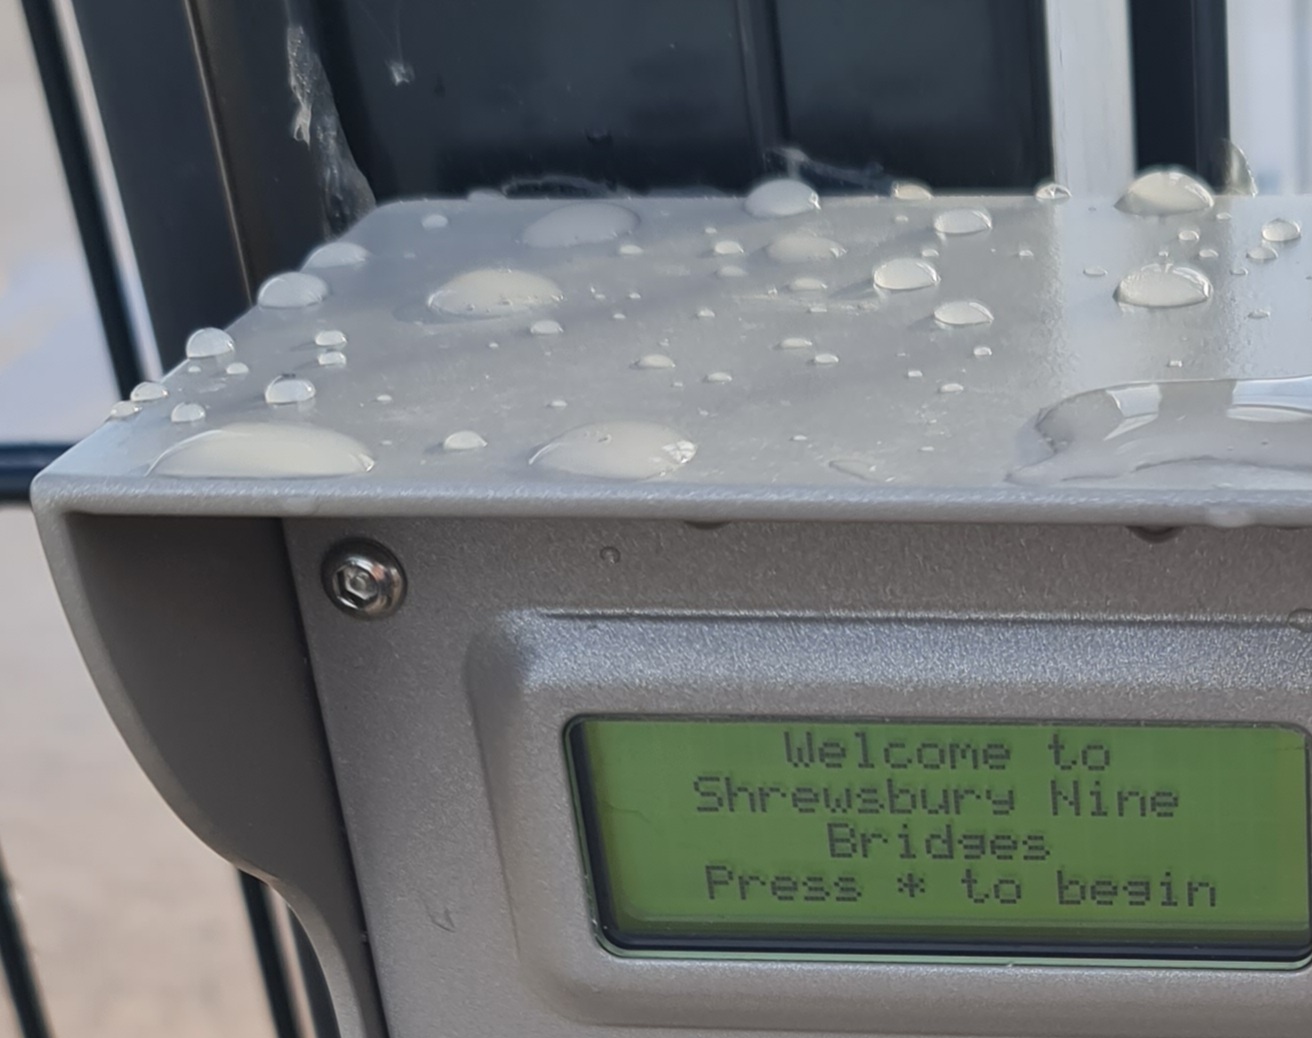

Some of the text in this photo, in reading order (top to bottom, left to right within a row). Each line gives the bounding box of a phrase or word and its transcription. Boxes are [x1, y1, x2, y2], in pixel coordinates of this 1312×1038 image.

[783, 731, 1112, 770] Welcome to
[693, 776, 1180, 818] Shrewsbury Nine
[828, 822, 1051, 861] Bridges
[705, 864, 863, 902] Press
[961, 869, 1022, 904] to
[1056, 870, 1217, 906] begin
